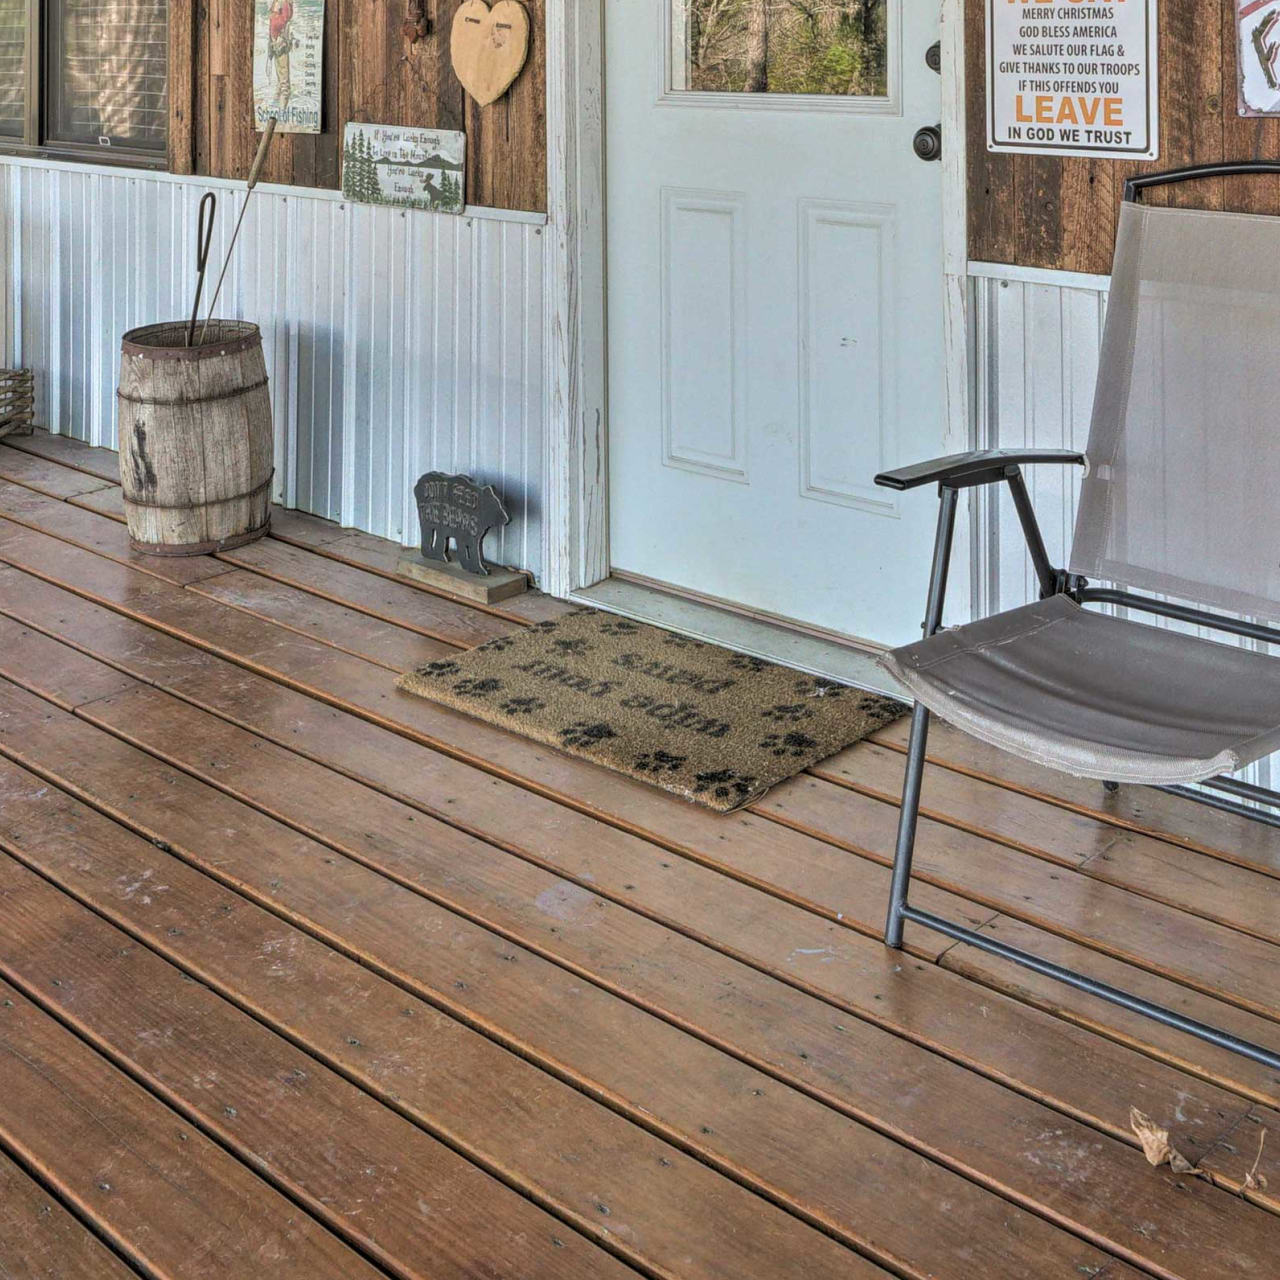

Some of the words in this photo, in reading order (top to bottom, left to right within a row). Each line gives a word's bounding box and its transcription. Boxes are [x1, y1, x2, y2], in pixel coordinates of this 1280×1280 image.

[1022, 7, 1055, 20] MERRY
[1057, 7, 1114, 20] CHRISTMAS
[1019, 25, 1039, 38] GOD
[1042, 25, 1070, 38] BLESS
[1072, 25, 1118, 38] AMERICA
[1012, 43, 1028, 56] WE
[1029, 43, 1065, 57] SALUTE
[1066, 44, 1088, 57] OUR
[1090, 44, 1115, 57] FLAG
[1116, 44, 1125, 57] &
[999, 61, 1021, 74] GIVE
[1023, 61, 1061, 75] THANKS
[1062, 62, 1075, 75] TO
[1077, 62, 1098, 75] OUR
[1099, 63, 1140, 76] TROOPS
[1018, 79, 1028, 92] IF
[1028, 79, 1051, 93] THIS
[1053, 80, 1097, 94] OFFENDS
[1098, 81, 1119, 94] YOU
[282, 106, 291, 124] of
[291, 106, 319, 129] Fishing
[1015, 94, 1124, 127] LEAVE
[419, 132, 440, 151] Enough
[1008, 126, 1022, 140] IN
[1026, 126, 1055, 141] GOD
[1059, 128, 1080, 142] WE
[1085, 129, 1132, 145] TRUST
